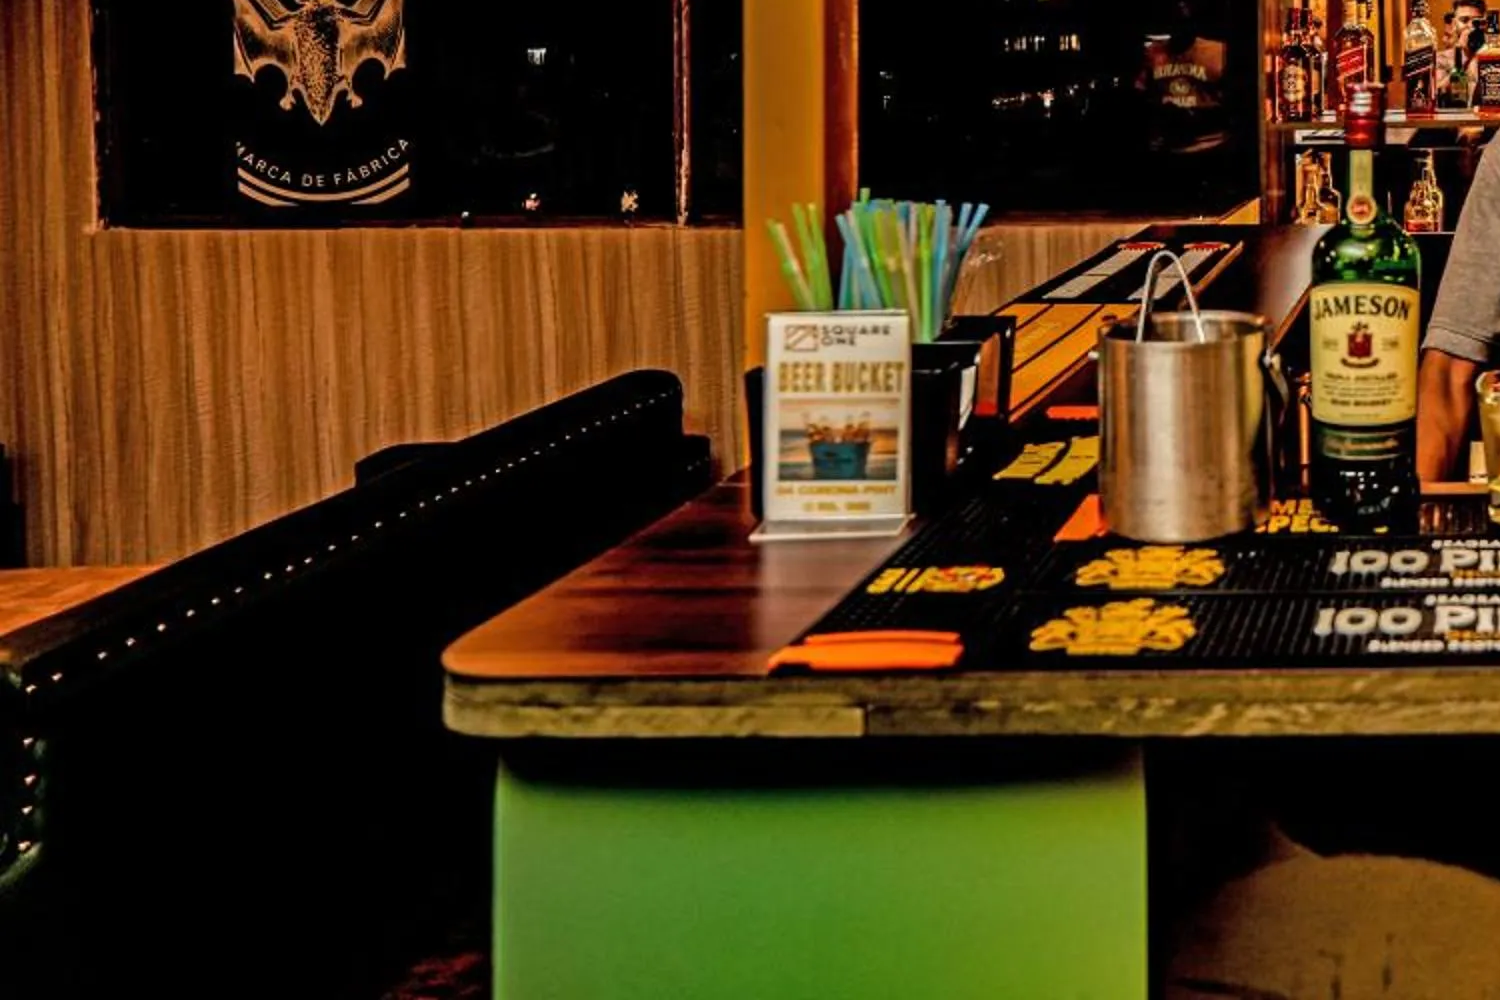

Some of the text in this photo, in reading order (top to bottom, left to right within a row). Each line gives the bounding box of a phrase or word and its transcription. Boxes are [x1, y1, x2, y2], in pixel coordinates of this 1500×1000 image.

[301, 173, 325, 187] DE
[1313, 294, 1412, 321] JAMESON
[821, 324, 891, 336] SQUARE
[778, 361, 905, 393] BEER BUCKET
[1330, 550, 1429, 575] 100
[1313, 606, 1423, 636] 100
